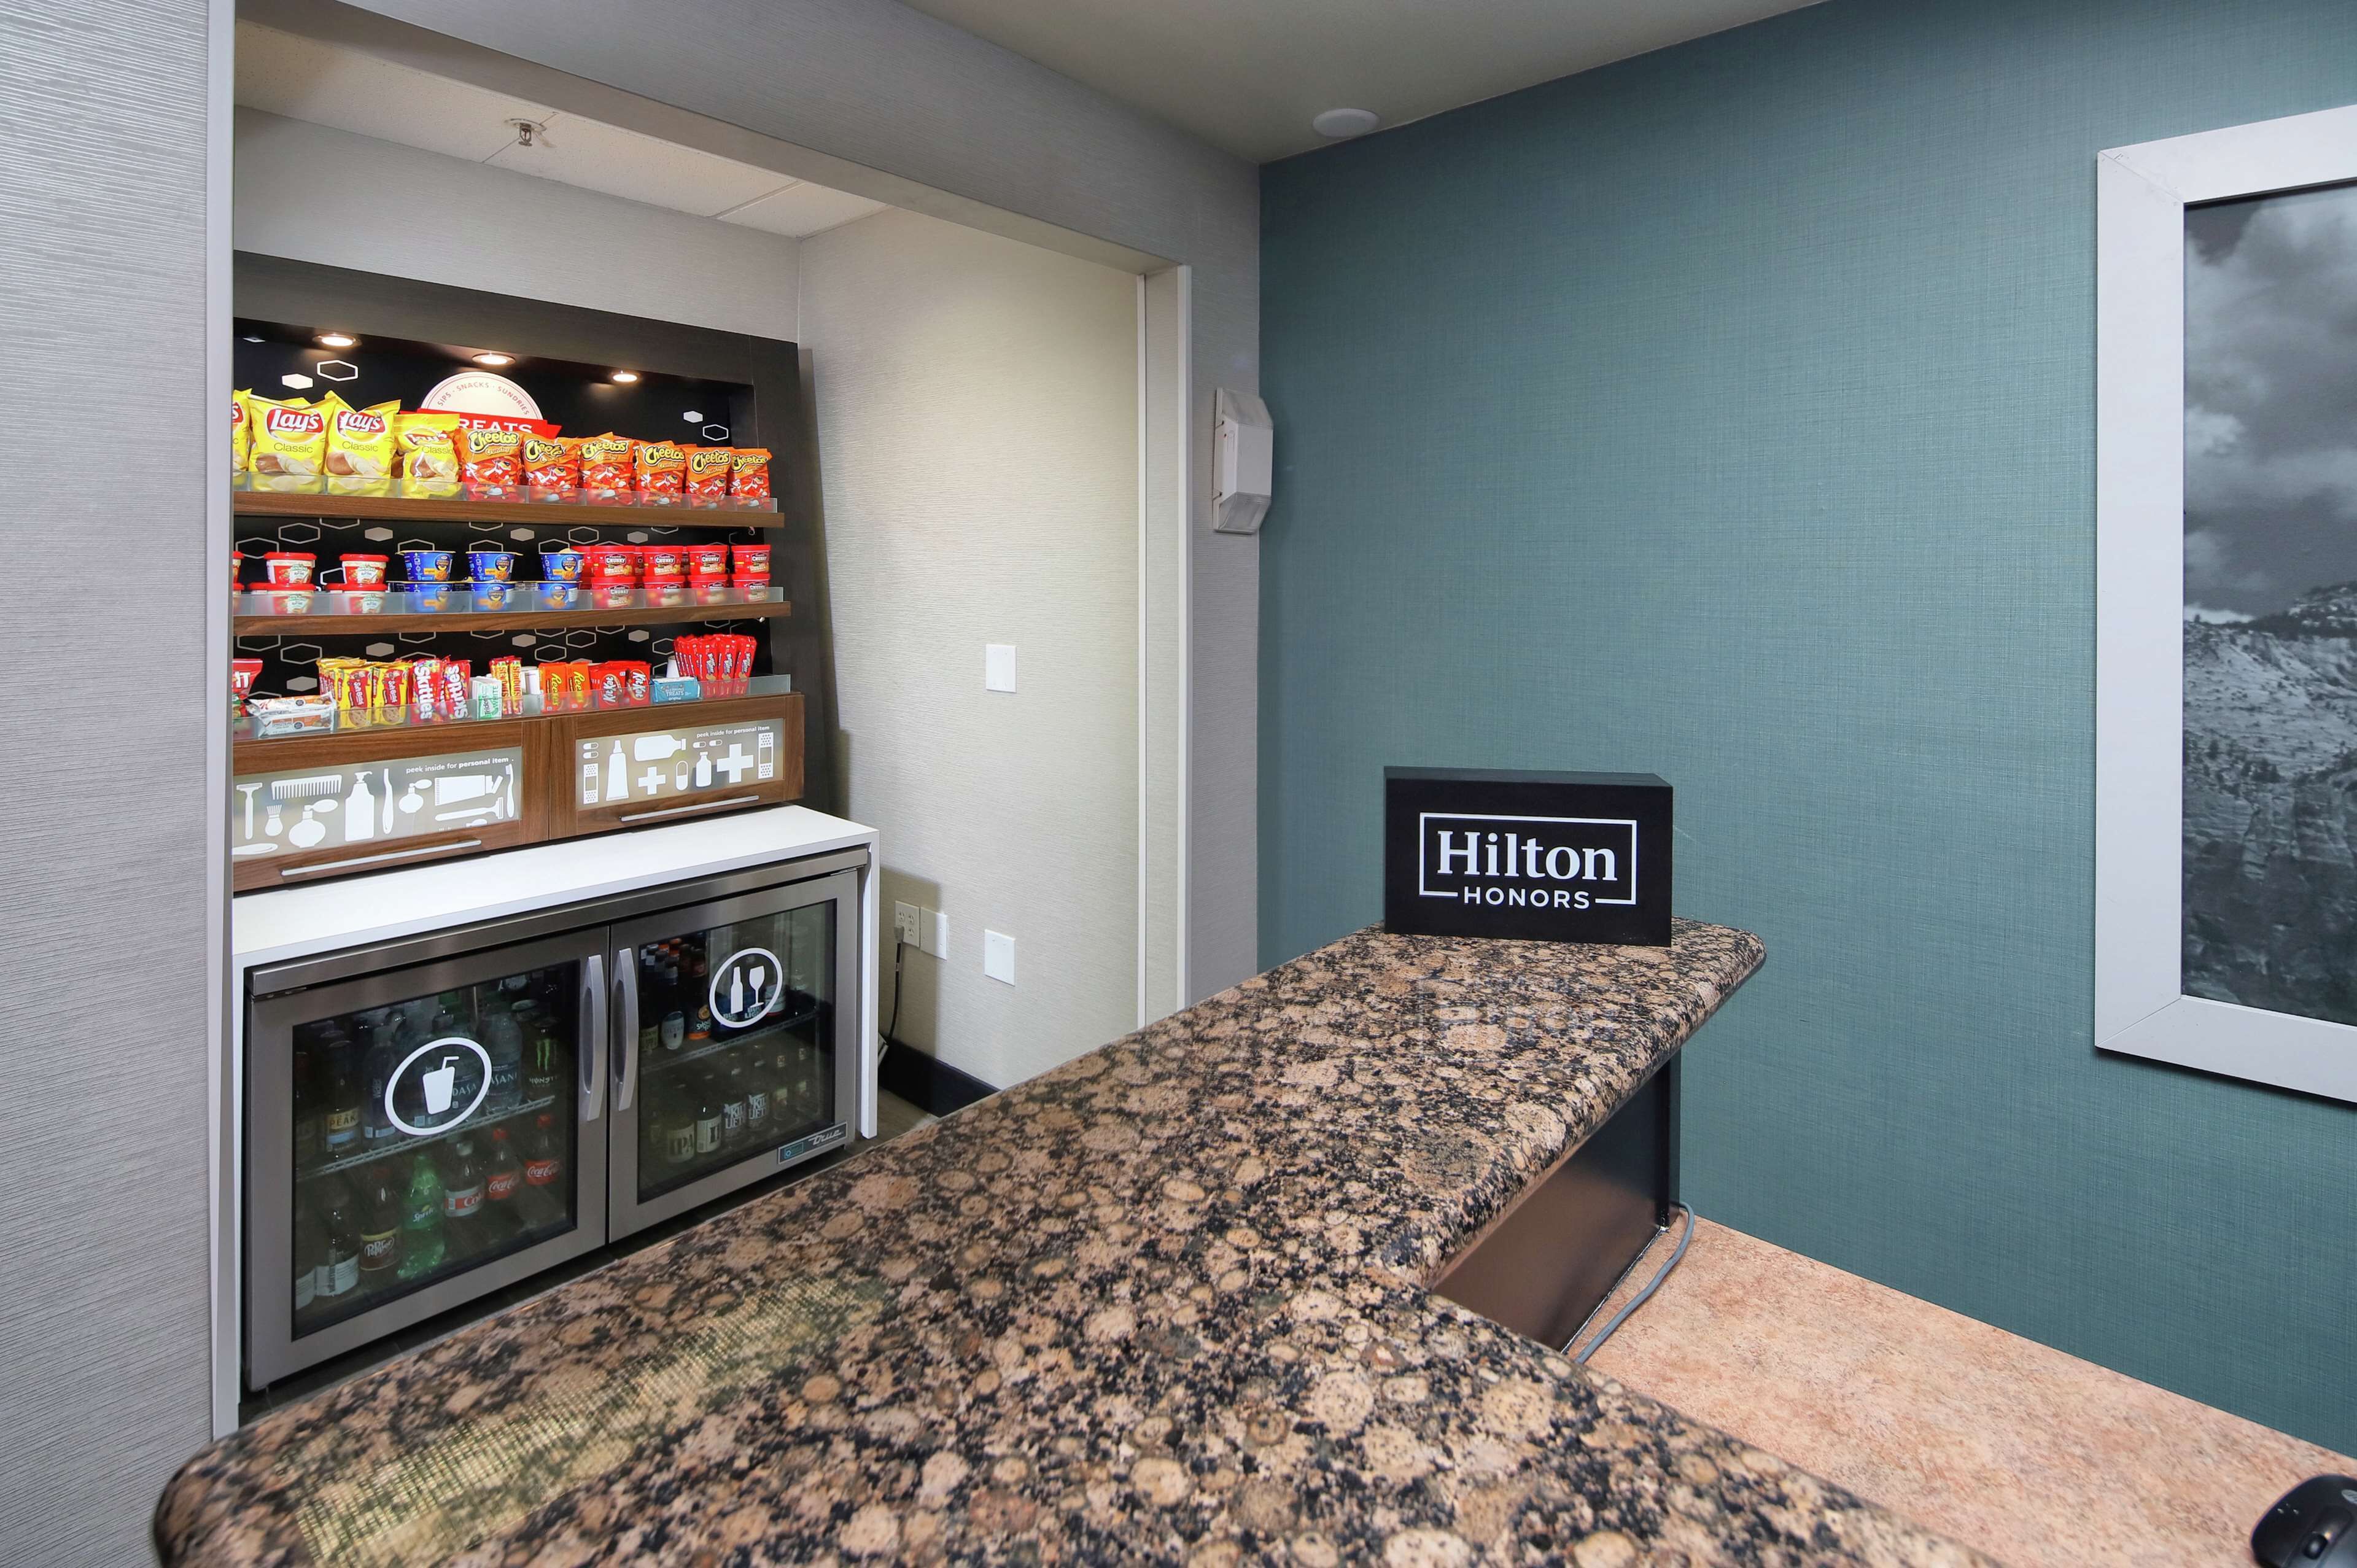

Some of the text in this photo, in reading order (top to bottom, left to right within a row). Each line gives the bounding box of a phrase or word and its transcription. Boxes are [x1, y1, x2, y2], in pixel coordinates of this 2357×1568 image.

[437, 382, 530, 415] SIPS SNACKS SUNDRIES
[270, 409, 320, 432] Lay's
[459, 419, 533, 433] REATS
[274, 442, 313, 453] Classic
[342, 441, 378, 452] Classic
[468, 432, 518, 451] Cheetos
[486, 446, 510, 455] Crunchy
[582, 441, 627, 460] Cheetos
[693, 451, 731, 472] Cheetos
[732, 454, 767, 472] Cheetos
[414, 666, 435, 720] Skittles
[448, 666, 468, 719] Skittles
[551, 673, 562, 705] Reese's
[603, 676, 616, 702] KitKat
[632, 672, 646, 698] KitKat
[459, 759, 491, 768] personal
[1437, 830, 1618, 881] Hilton
[1464, 885, 1590, 909] HONORS
[491, 1073, 518, 1086] ASANI
[452, 1083, 477, 1096] DASA
[731, 1106, 743, 1117] KIL
[753, 1096, 766, 1109] KIL
[329, 1116, 355, 1127] PEAK
